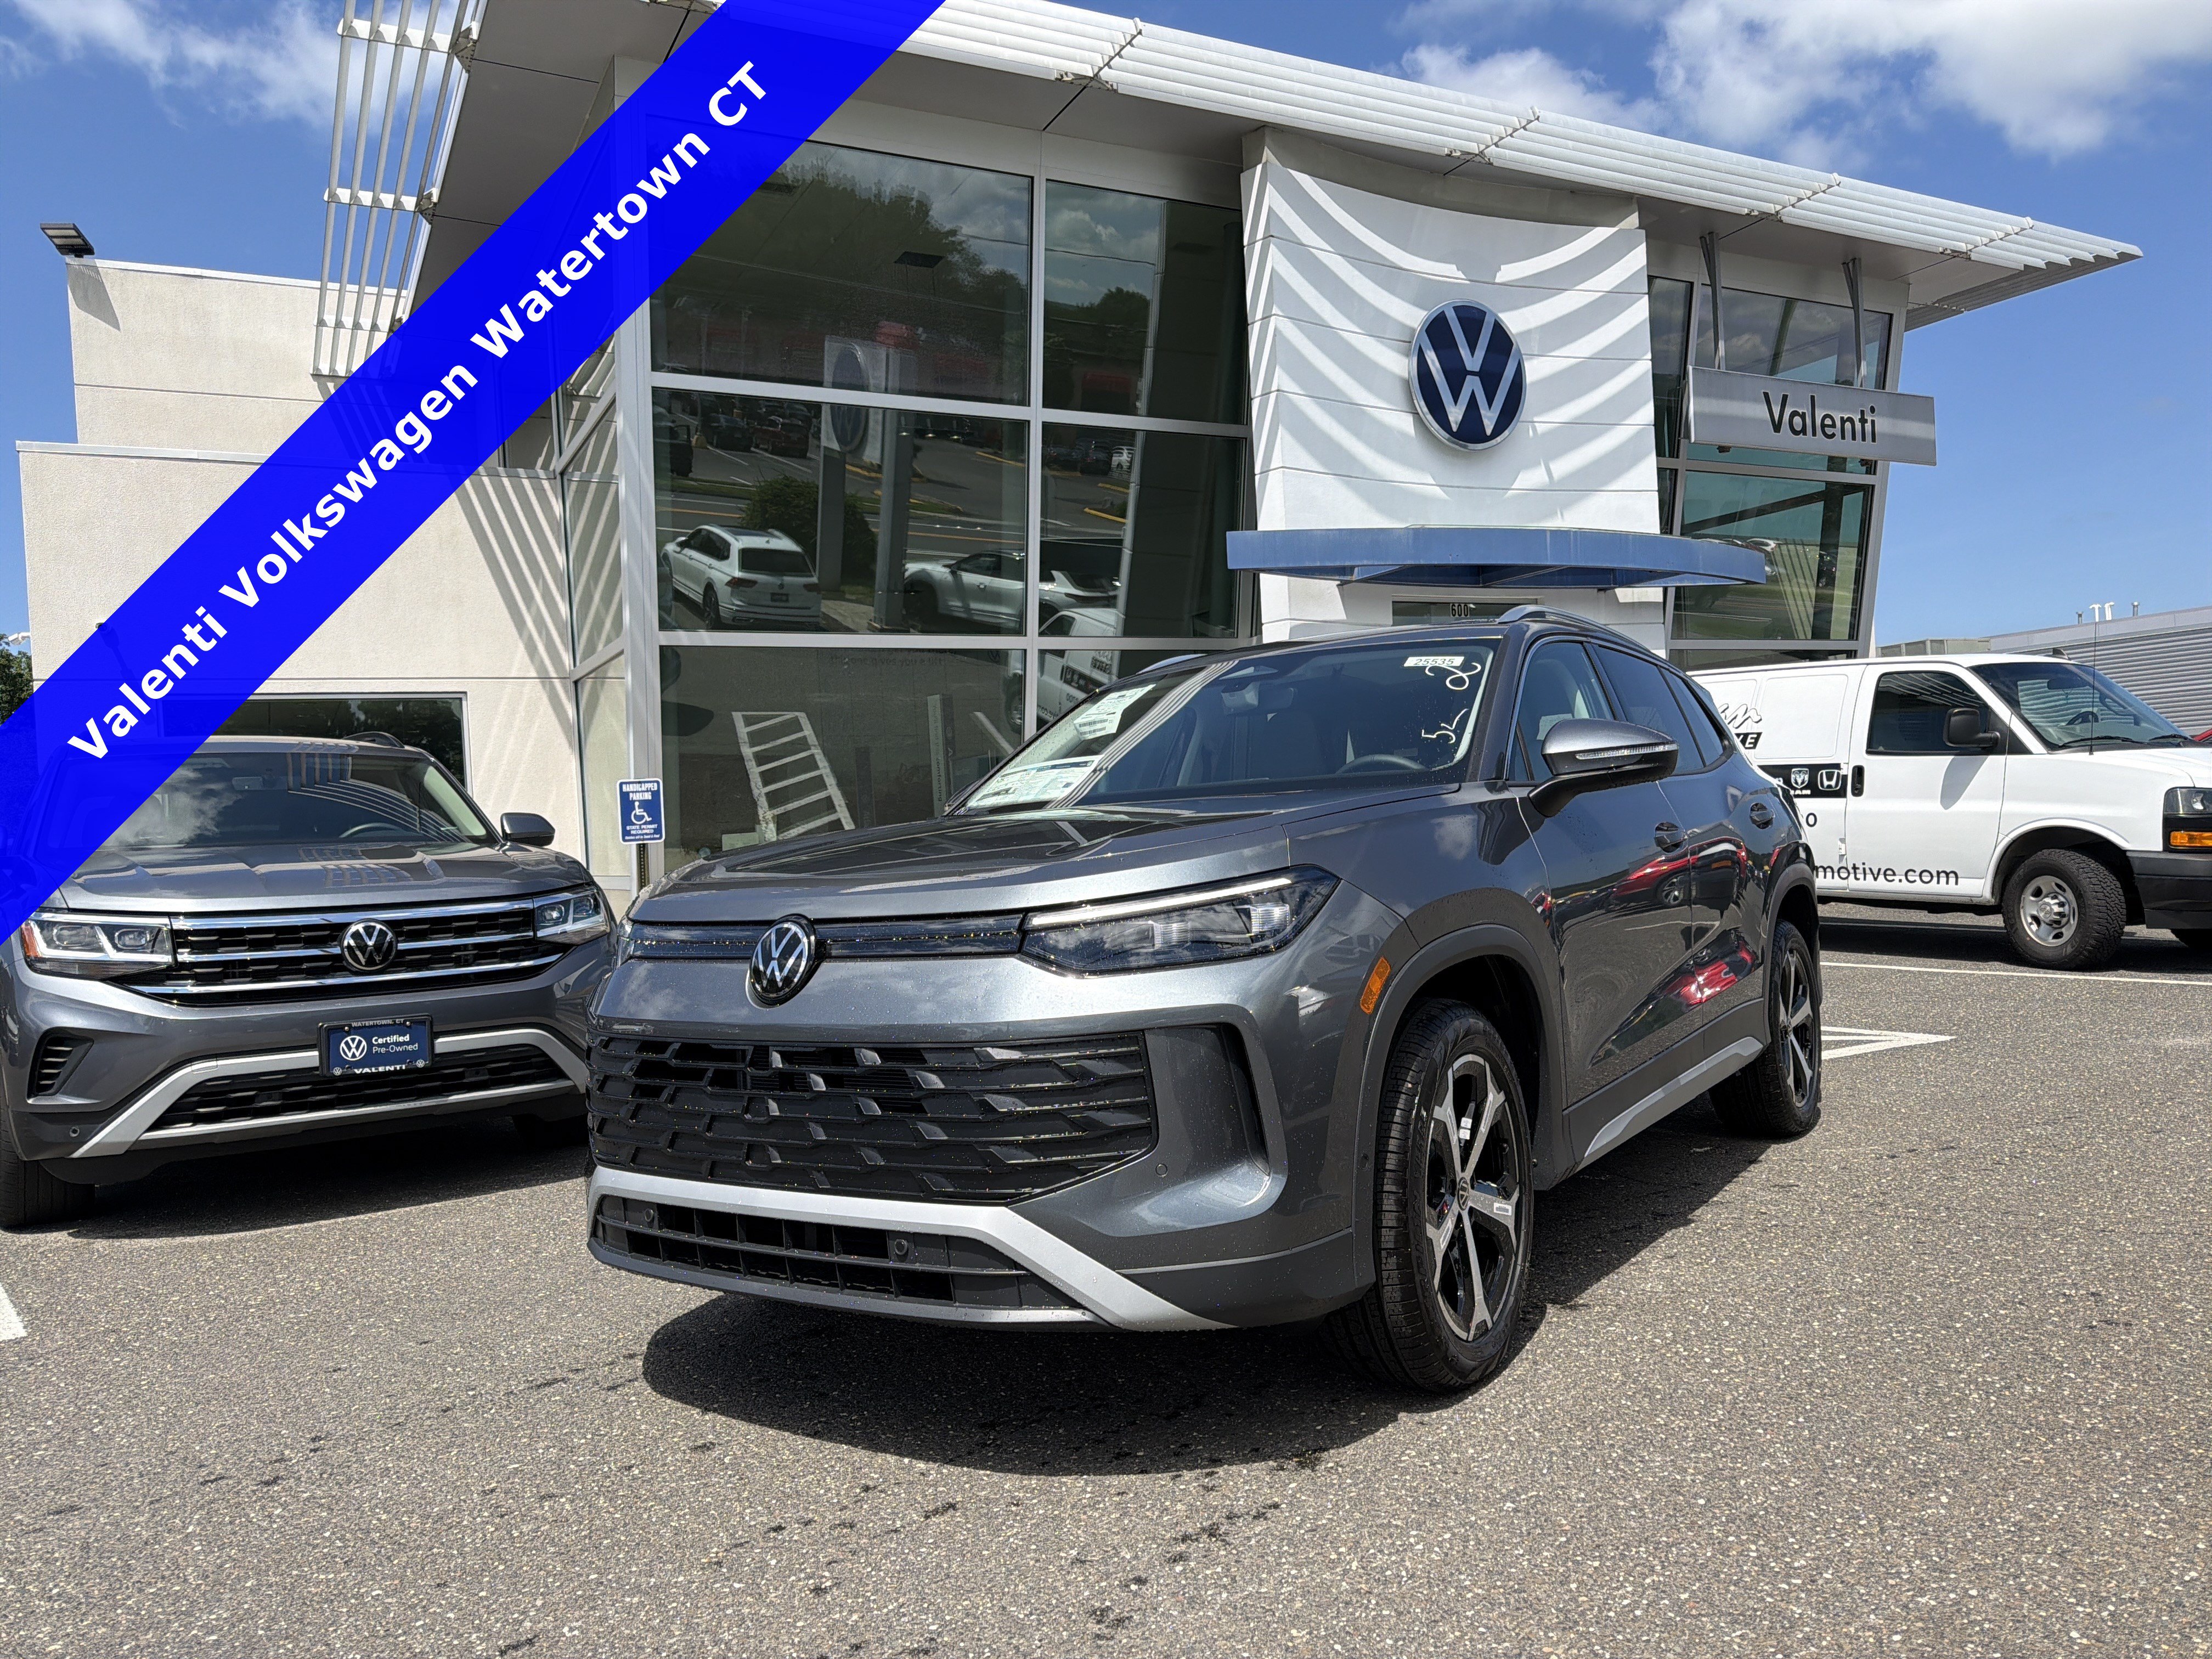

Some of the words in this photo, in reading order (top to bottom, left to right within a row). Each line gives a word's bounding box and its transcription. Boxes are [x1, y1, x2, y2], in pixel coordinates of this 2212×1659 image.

[1762, 391, 1877, 443] Valenti
[1451, 604, 1469, 617] 600
[622, 783, 658, 792] HANDICAPPED
[629, 792, 652, 800] PARKING
[372, 1034, 409, 1044] Certified
[373, 1043, 418, 1054] Pre-Owned
[353, 1064, 407, 1074] VALENTI
